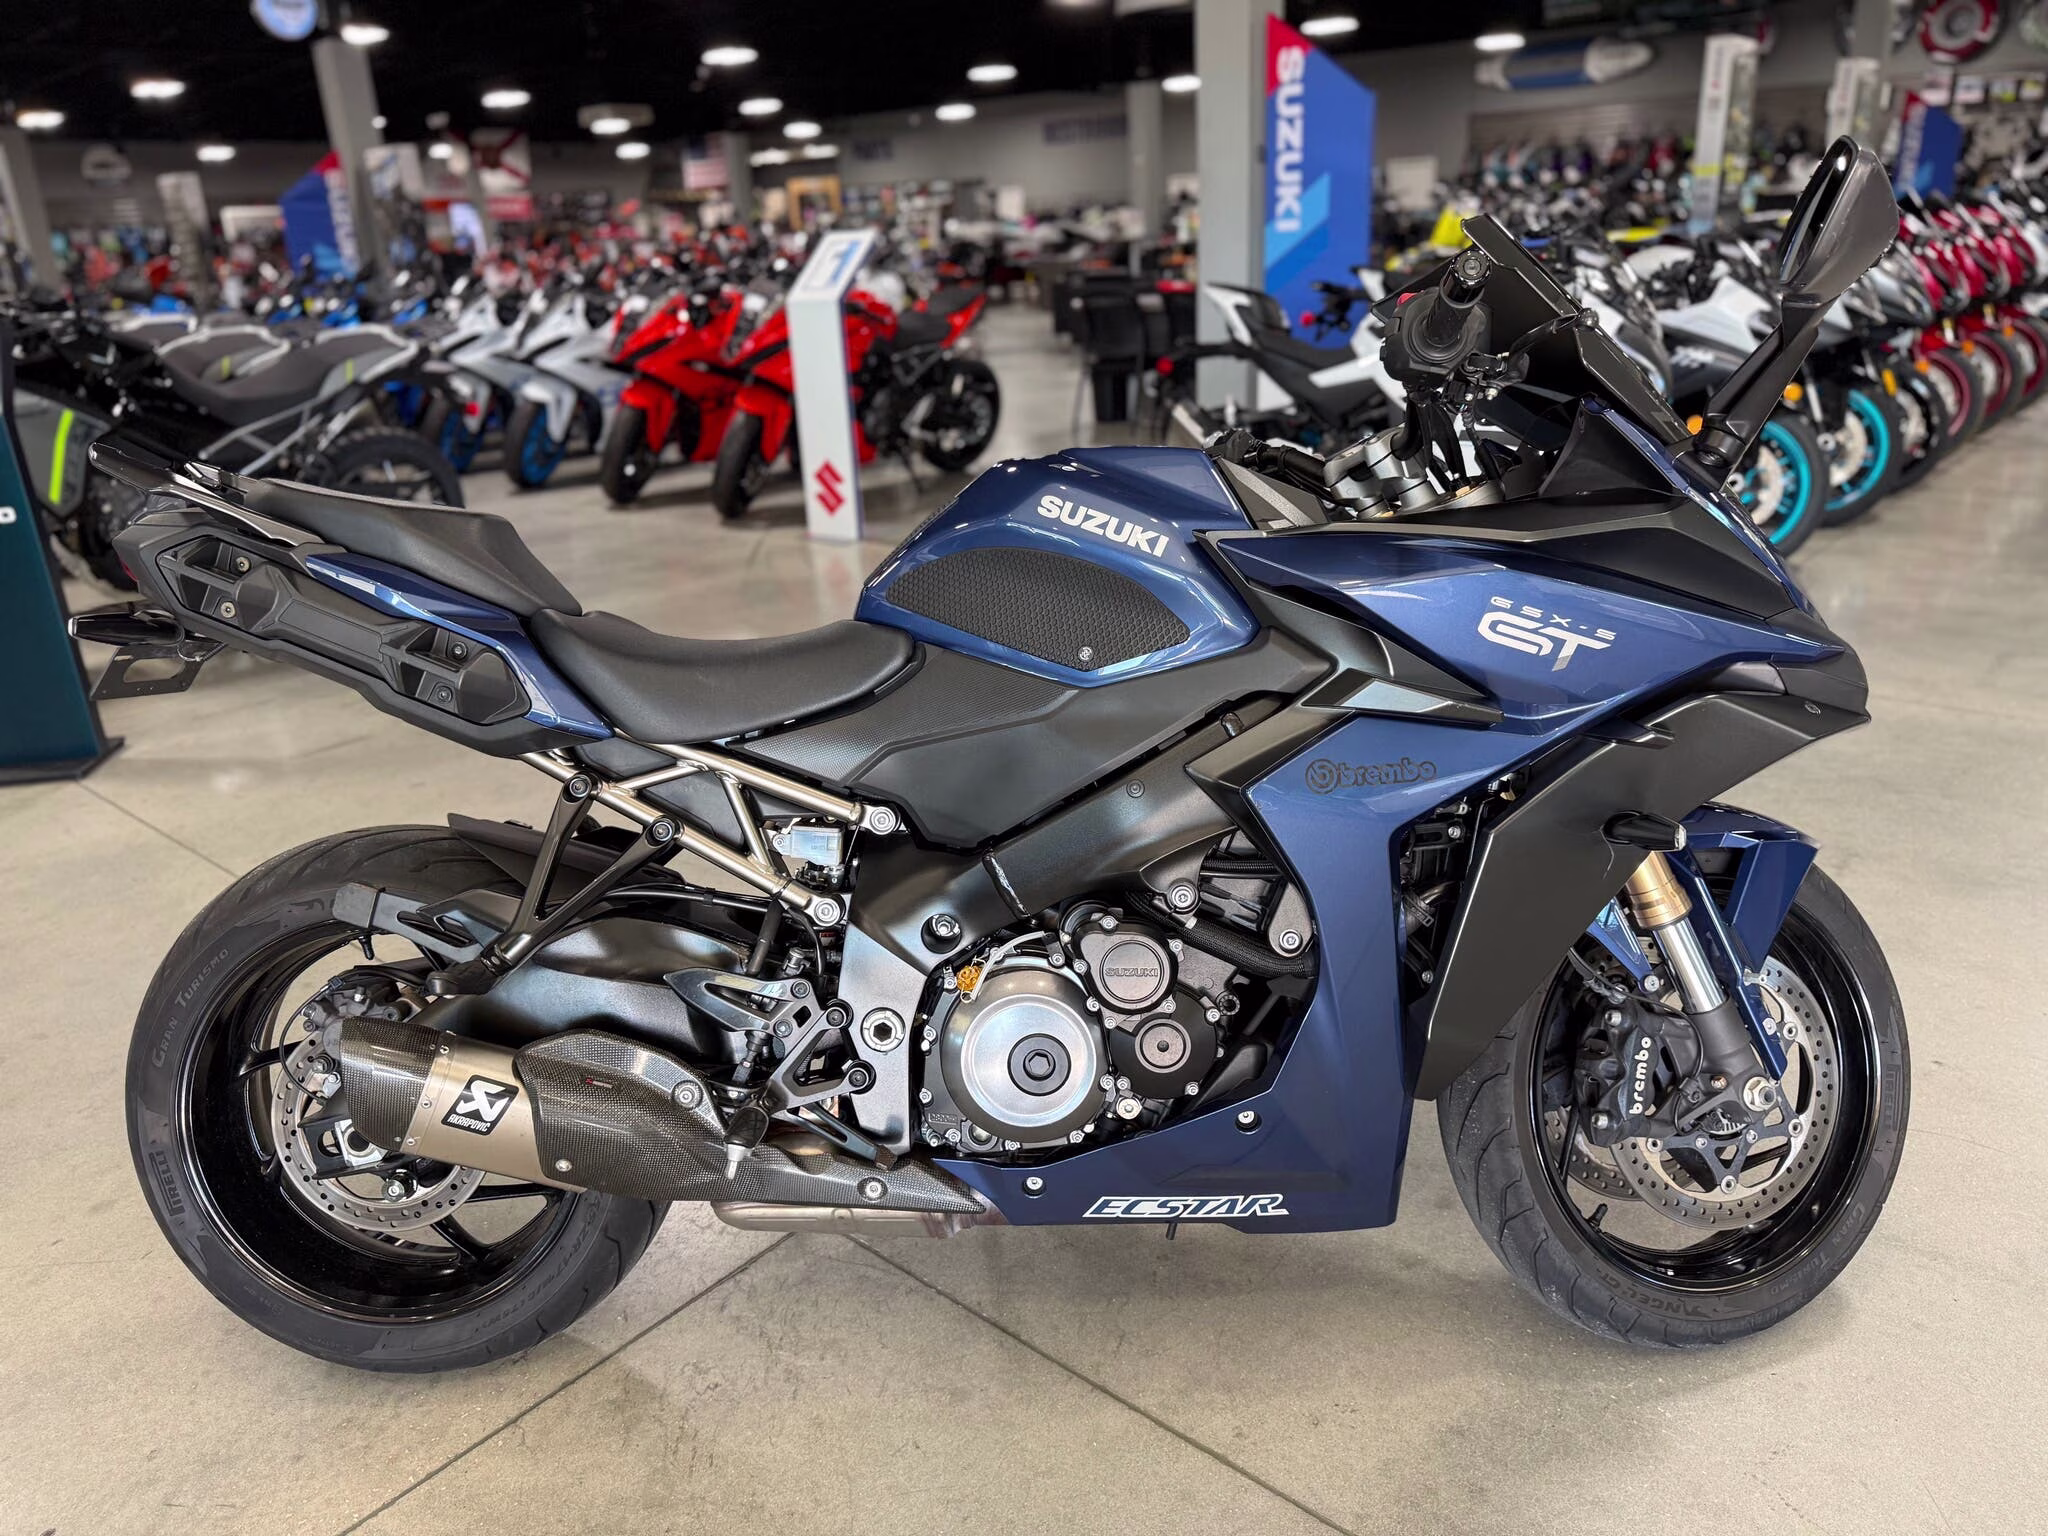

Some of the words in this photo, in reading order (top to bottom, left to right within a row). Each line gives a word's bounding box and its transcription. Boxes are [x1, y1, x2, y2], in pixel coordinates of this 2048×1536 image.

[1274, 45, 1305, 232] SUZUKI
[1037, 495, 1170, 558] SUZUKI
[1477, 611, 1612, 672] GT
[1490, 596, 1617, 640] GSX-S
[1337, 757, 1437, 788] brembo
[1104, 967, 1159, 978] SUZUKI
[1628, 1036, 1652, 1115] brembo
[148, 1149, 186, 1217] PIRELLI
[1081, 1193, 1290, 1218] ECSTAR
